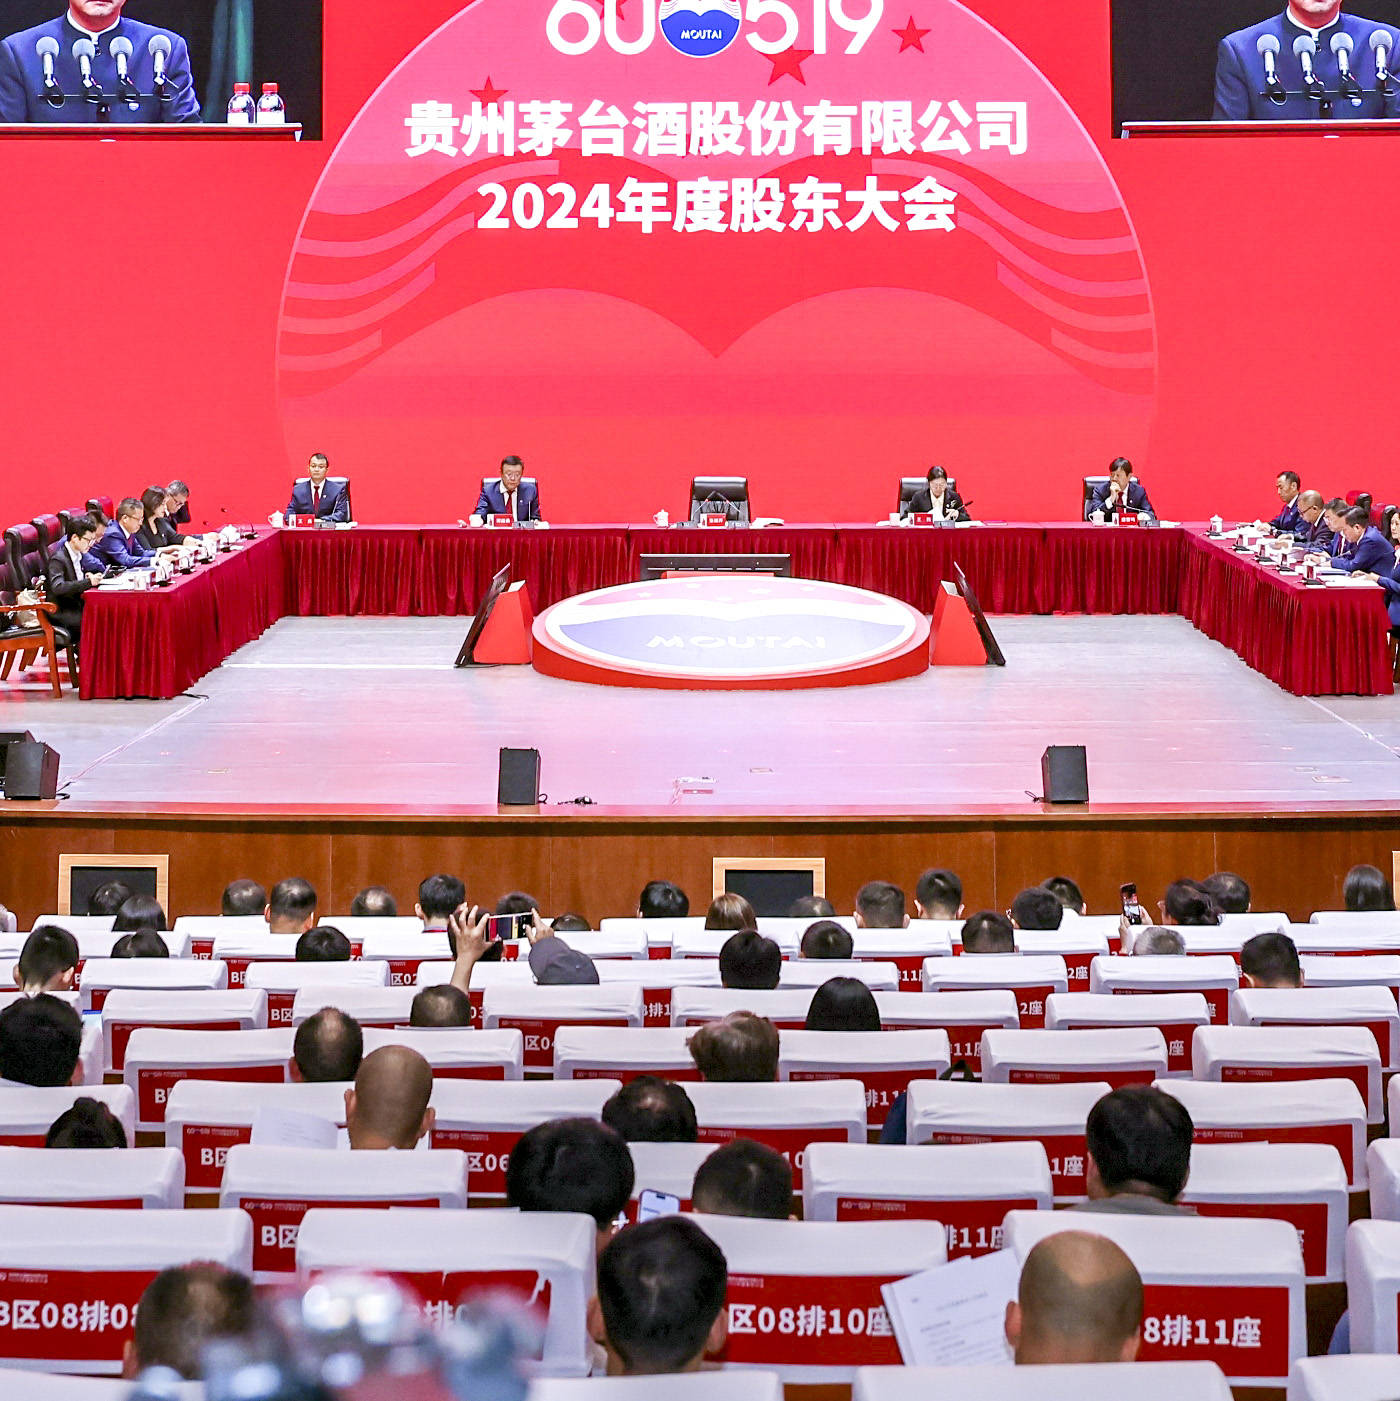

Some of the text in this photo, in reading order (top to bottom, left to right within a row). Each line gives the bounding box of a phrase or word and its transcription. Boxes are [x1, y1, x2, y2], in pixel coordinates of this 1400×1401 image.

[680, 29, 722, 40] MOUTAI
[403, 99, 1028, 157] 贵州茅台酒股份有限公司
[476, 176, 958, 233] 2024年度股东大会
[646, 635, 826, 649] MOUTAI
